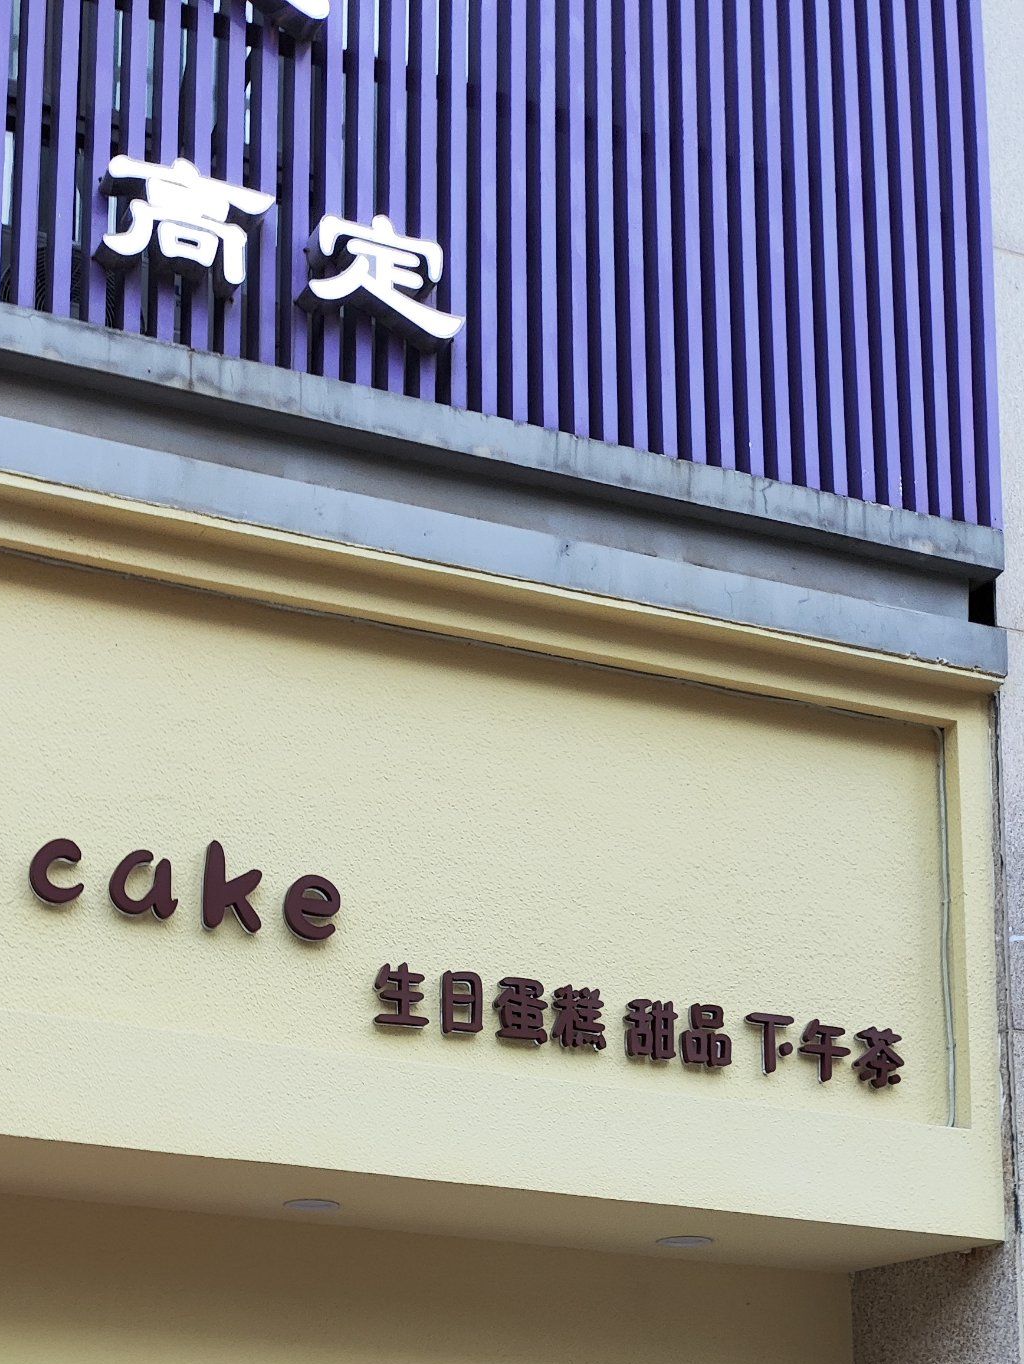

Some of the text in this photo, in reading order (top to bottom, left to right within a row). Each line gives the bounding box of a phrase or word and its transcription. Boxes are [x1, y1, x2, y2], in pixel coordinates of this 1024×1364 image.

[104, 154, 466, 341] 高定
[29, 839, 341, 943] cake
[373, 961, 906, 1089] 生日蛋糕 甜品 下午茶
